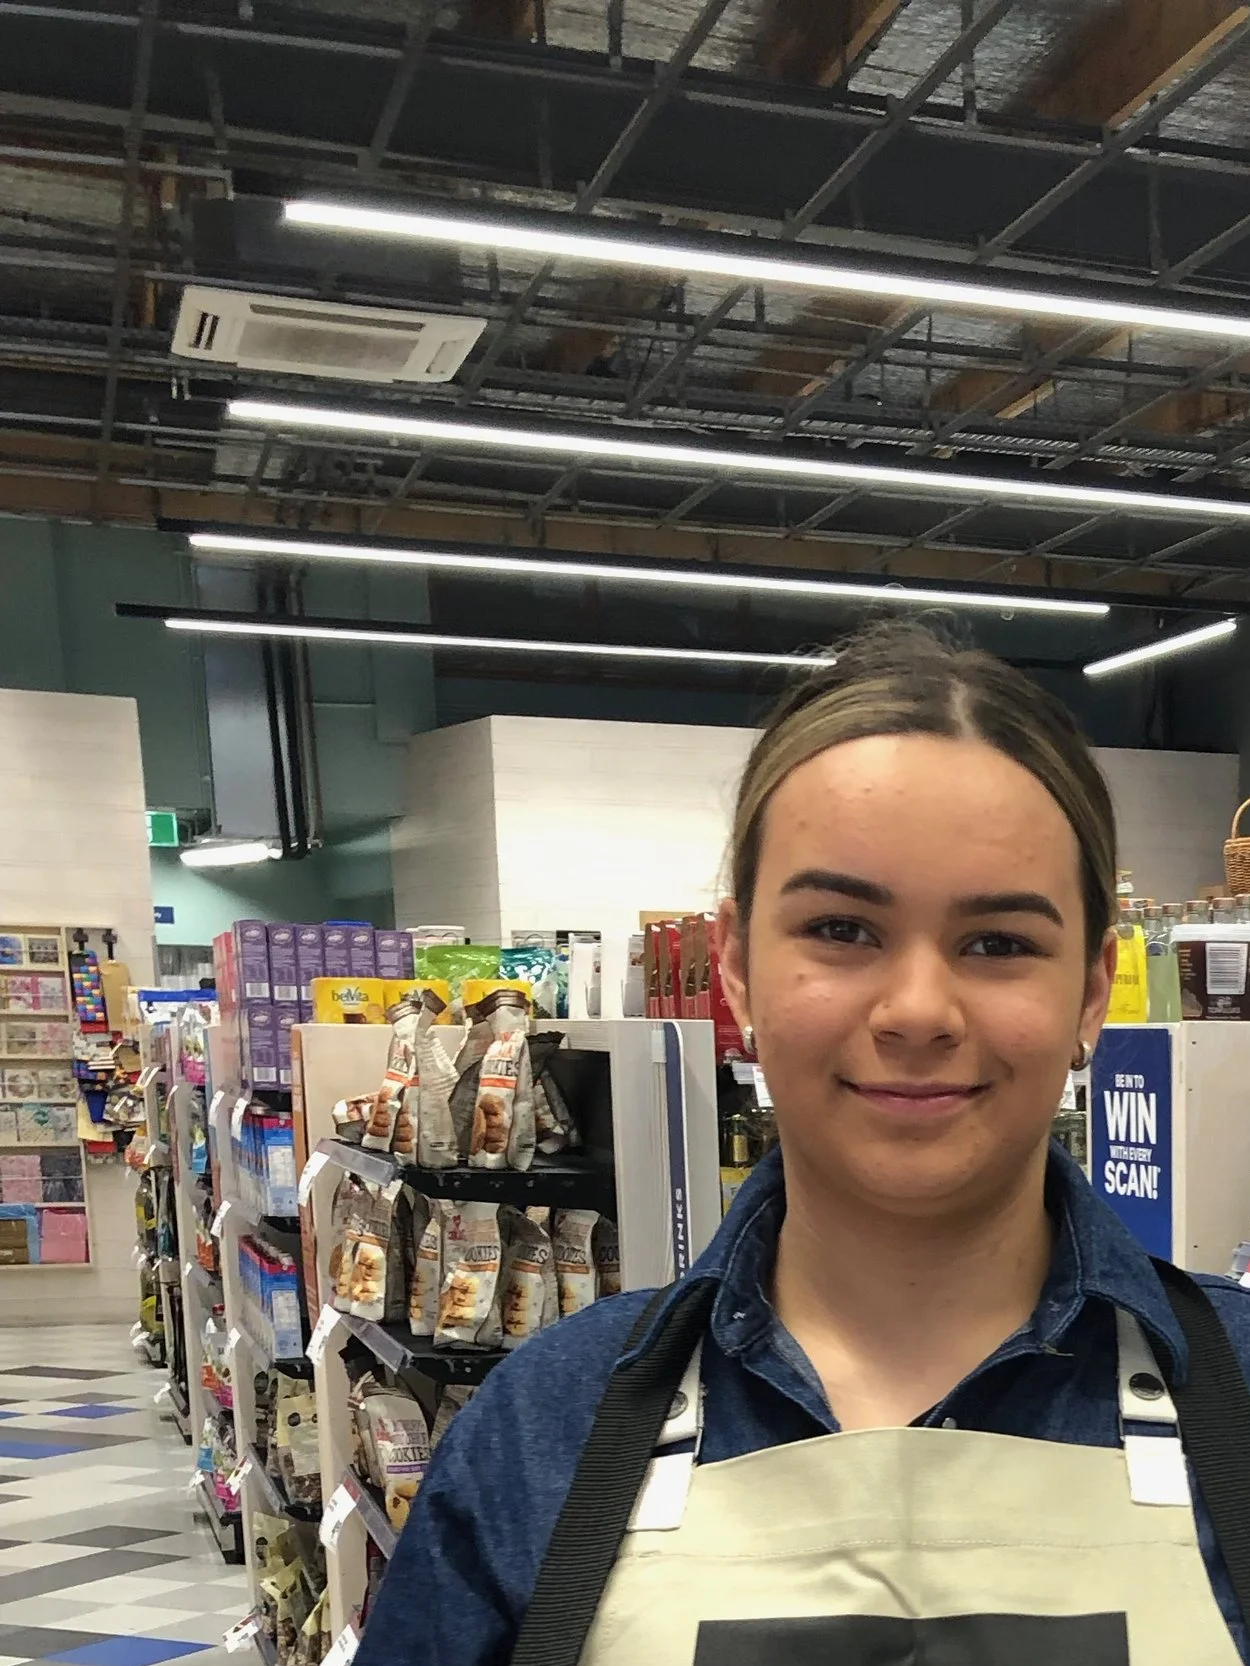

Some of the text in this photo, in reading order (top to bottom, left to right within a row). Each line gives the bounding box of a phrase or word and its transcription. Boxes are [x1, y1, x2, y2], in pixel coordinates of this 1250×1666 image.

[1115, 1074, 1125, 1088] BE
[1134, 1075, 1145, 1089] TO
[1104, 1090, 1157, 1145] WIN
[1109, 1144, 1153, 1163] WITH EVERY
[675, 1187, 688, 1278] RINKS
